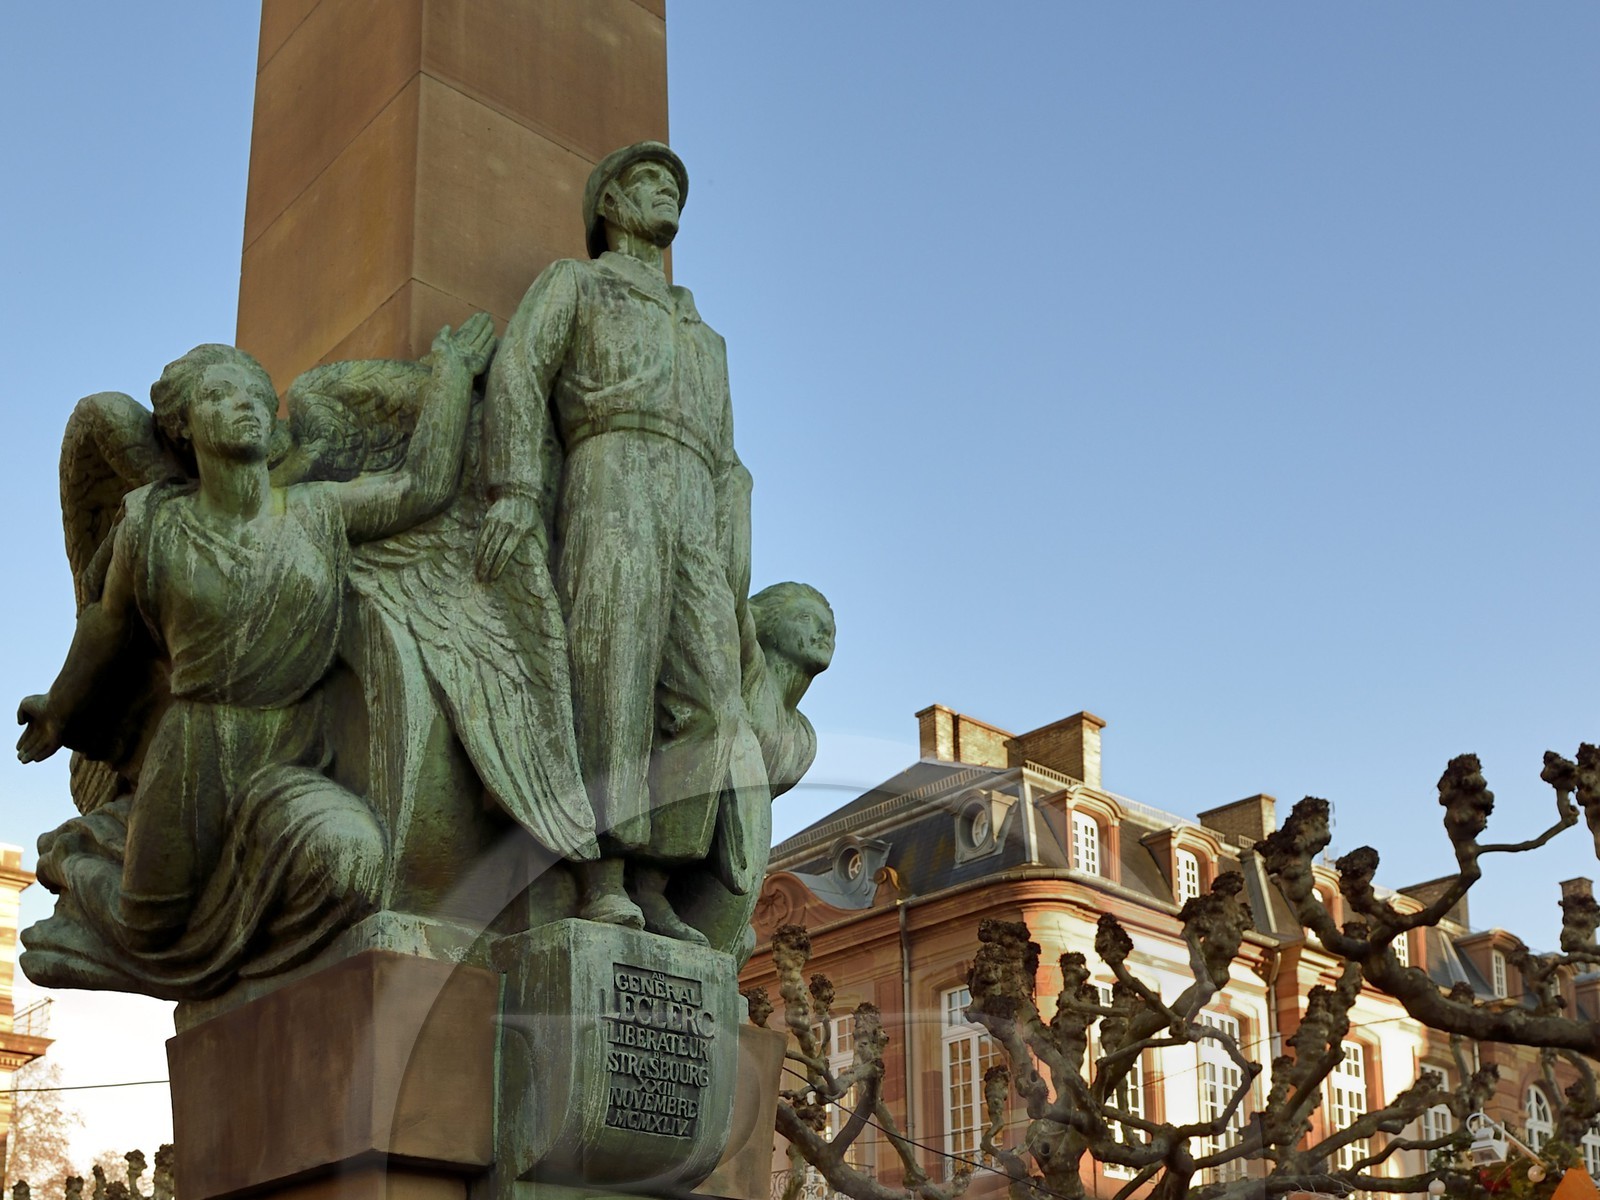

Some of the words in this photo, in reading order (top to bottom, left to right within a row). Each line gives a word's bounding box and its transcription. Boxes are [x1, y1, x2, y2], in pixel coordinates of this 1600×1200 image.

[615, 973, 702, 1007] GENERAL
[652, 972, 665, 981] AU
[602, 992, 715, 1038] LECLERC
[607, 1021, 709, 1062] LIBERATEUR
[606, 1051, 709, 1087] STRASBOURG
[609, 1087, 698, 1118] NOVEMBRE
[637, 1077, 676, 1096] XXIII
[613, 1109, 690, 1136] MCMXLIV
